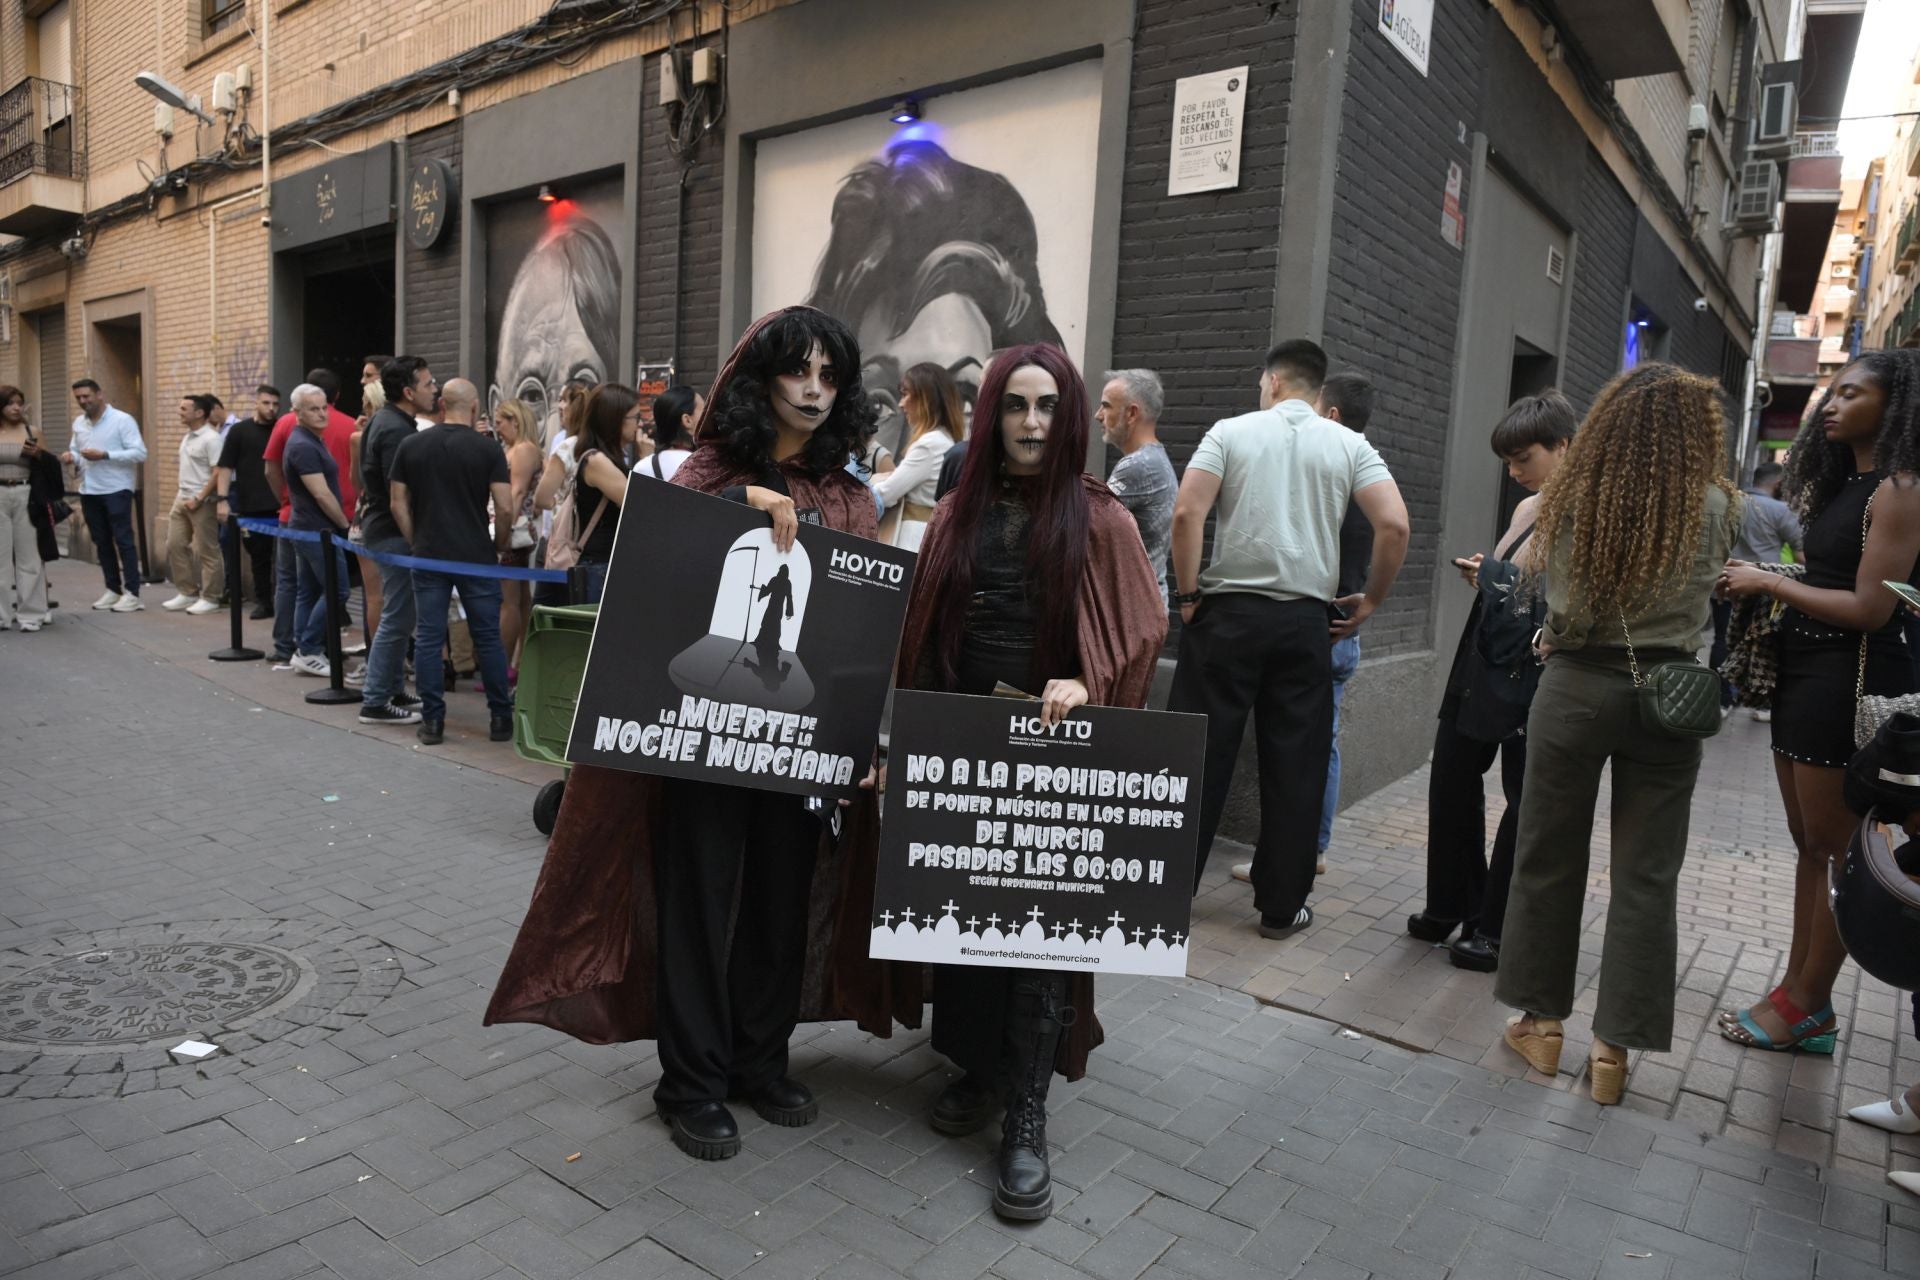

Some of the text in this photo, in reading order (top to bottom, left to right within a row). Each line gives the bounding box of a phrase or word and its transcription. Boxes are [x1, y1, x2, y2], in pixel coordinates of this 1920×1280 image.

[1393, 12, 1426, 62] AGÜERA
[1180, 107, 1230, 125] RESPETA EL
[1182, 97, 1227, 114] POR FAVOR
[1179, 128, 1234, 146] LOS VECINOS
[1180, 116, 1235, 135] DESCANSO DE
[411, 179, 438, 209] Black
[415, 205, 435, 237] Tag
[659, 694, 818, 747] LA MUERTE DE LA
[593, 716, 855, 786] NOCHE MURCIANA
[907, 754, 1188, 804] NO A LA PROHIBICIÓN
[906, 790, 1184, 828] DE PONER MÚSICA EN LOS BARES
[976, 820, 1104, 852] DE MURCIA
[908, 842, 1165, 884] PASADAS LAS 00:00 H
[969, 874, 1105, 894] SEGÚN ORDENANZA MUNICIPAL
[959, 946, 1101, 964] #lamuertedelanochemurciana
